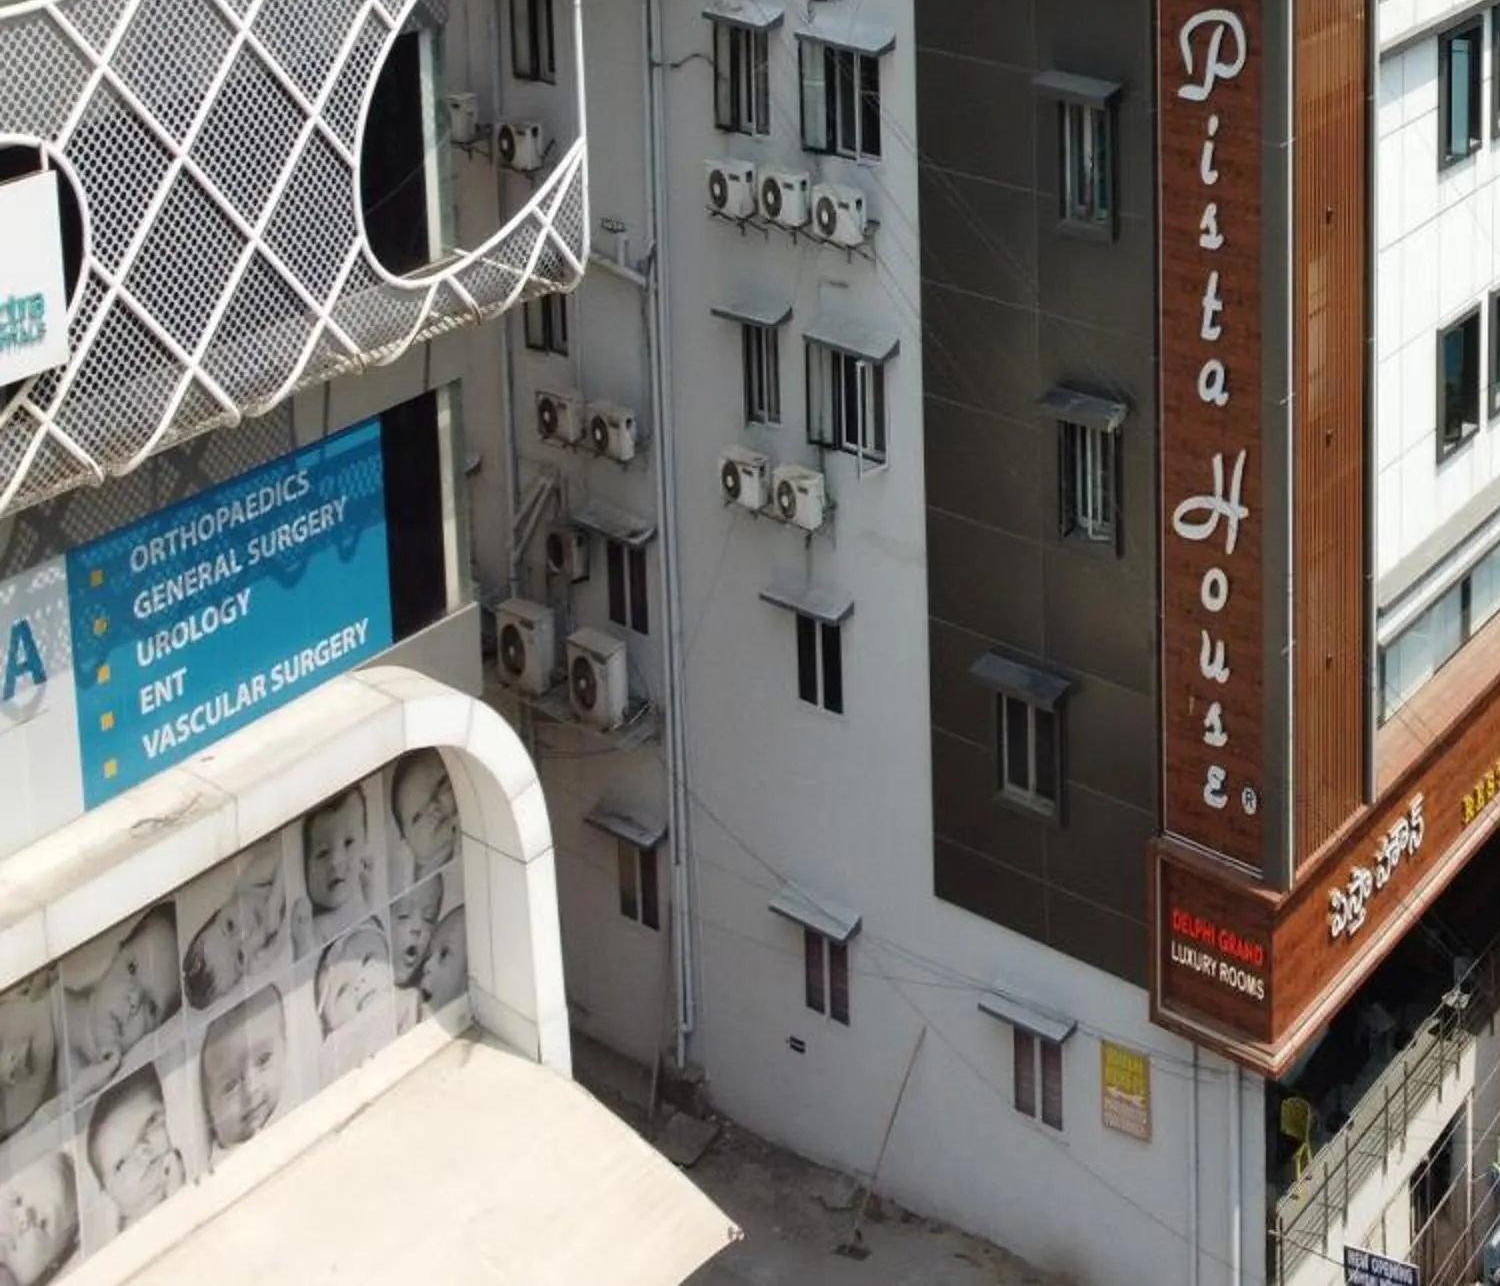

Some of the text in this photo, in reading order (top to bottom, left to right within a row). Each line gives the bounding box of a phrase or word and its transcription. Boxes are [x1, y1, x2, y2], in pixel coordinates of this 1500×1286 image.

[1173, 8, 1249, 809] Pista House
[130, 470, 311, 572] ORTHOPAEDICS
[133, 496, 348, 620] GENERAL SURGERY
[1, 617, 48, 702] A
[136, 589, 252, 667] UROLOGY
[139, 666, 188, 715] ENT
[142, 617, 371, 759] VASCULAR SURGERY
[1171, 940, 1265, 1001] LUXURY ROOMS
[1172, 908, 1264, 967] DELPHI GRAND
